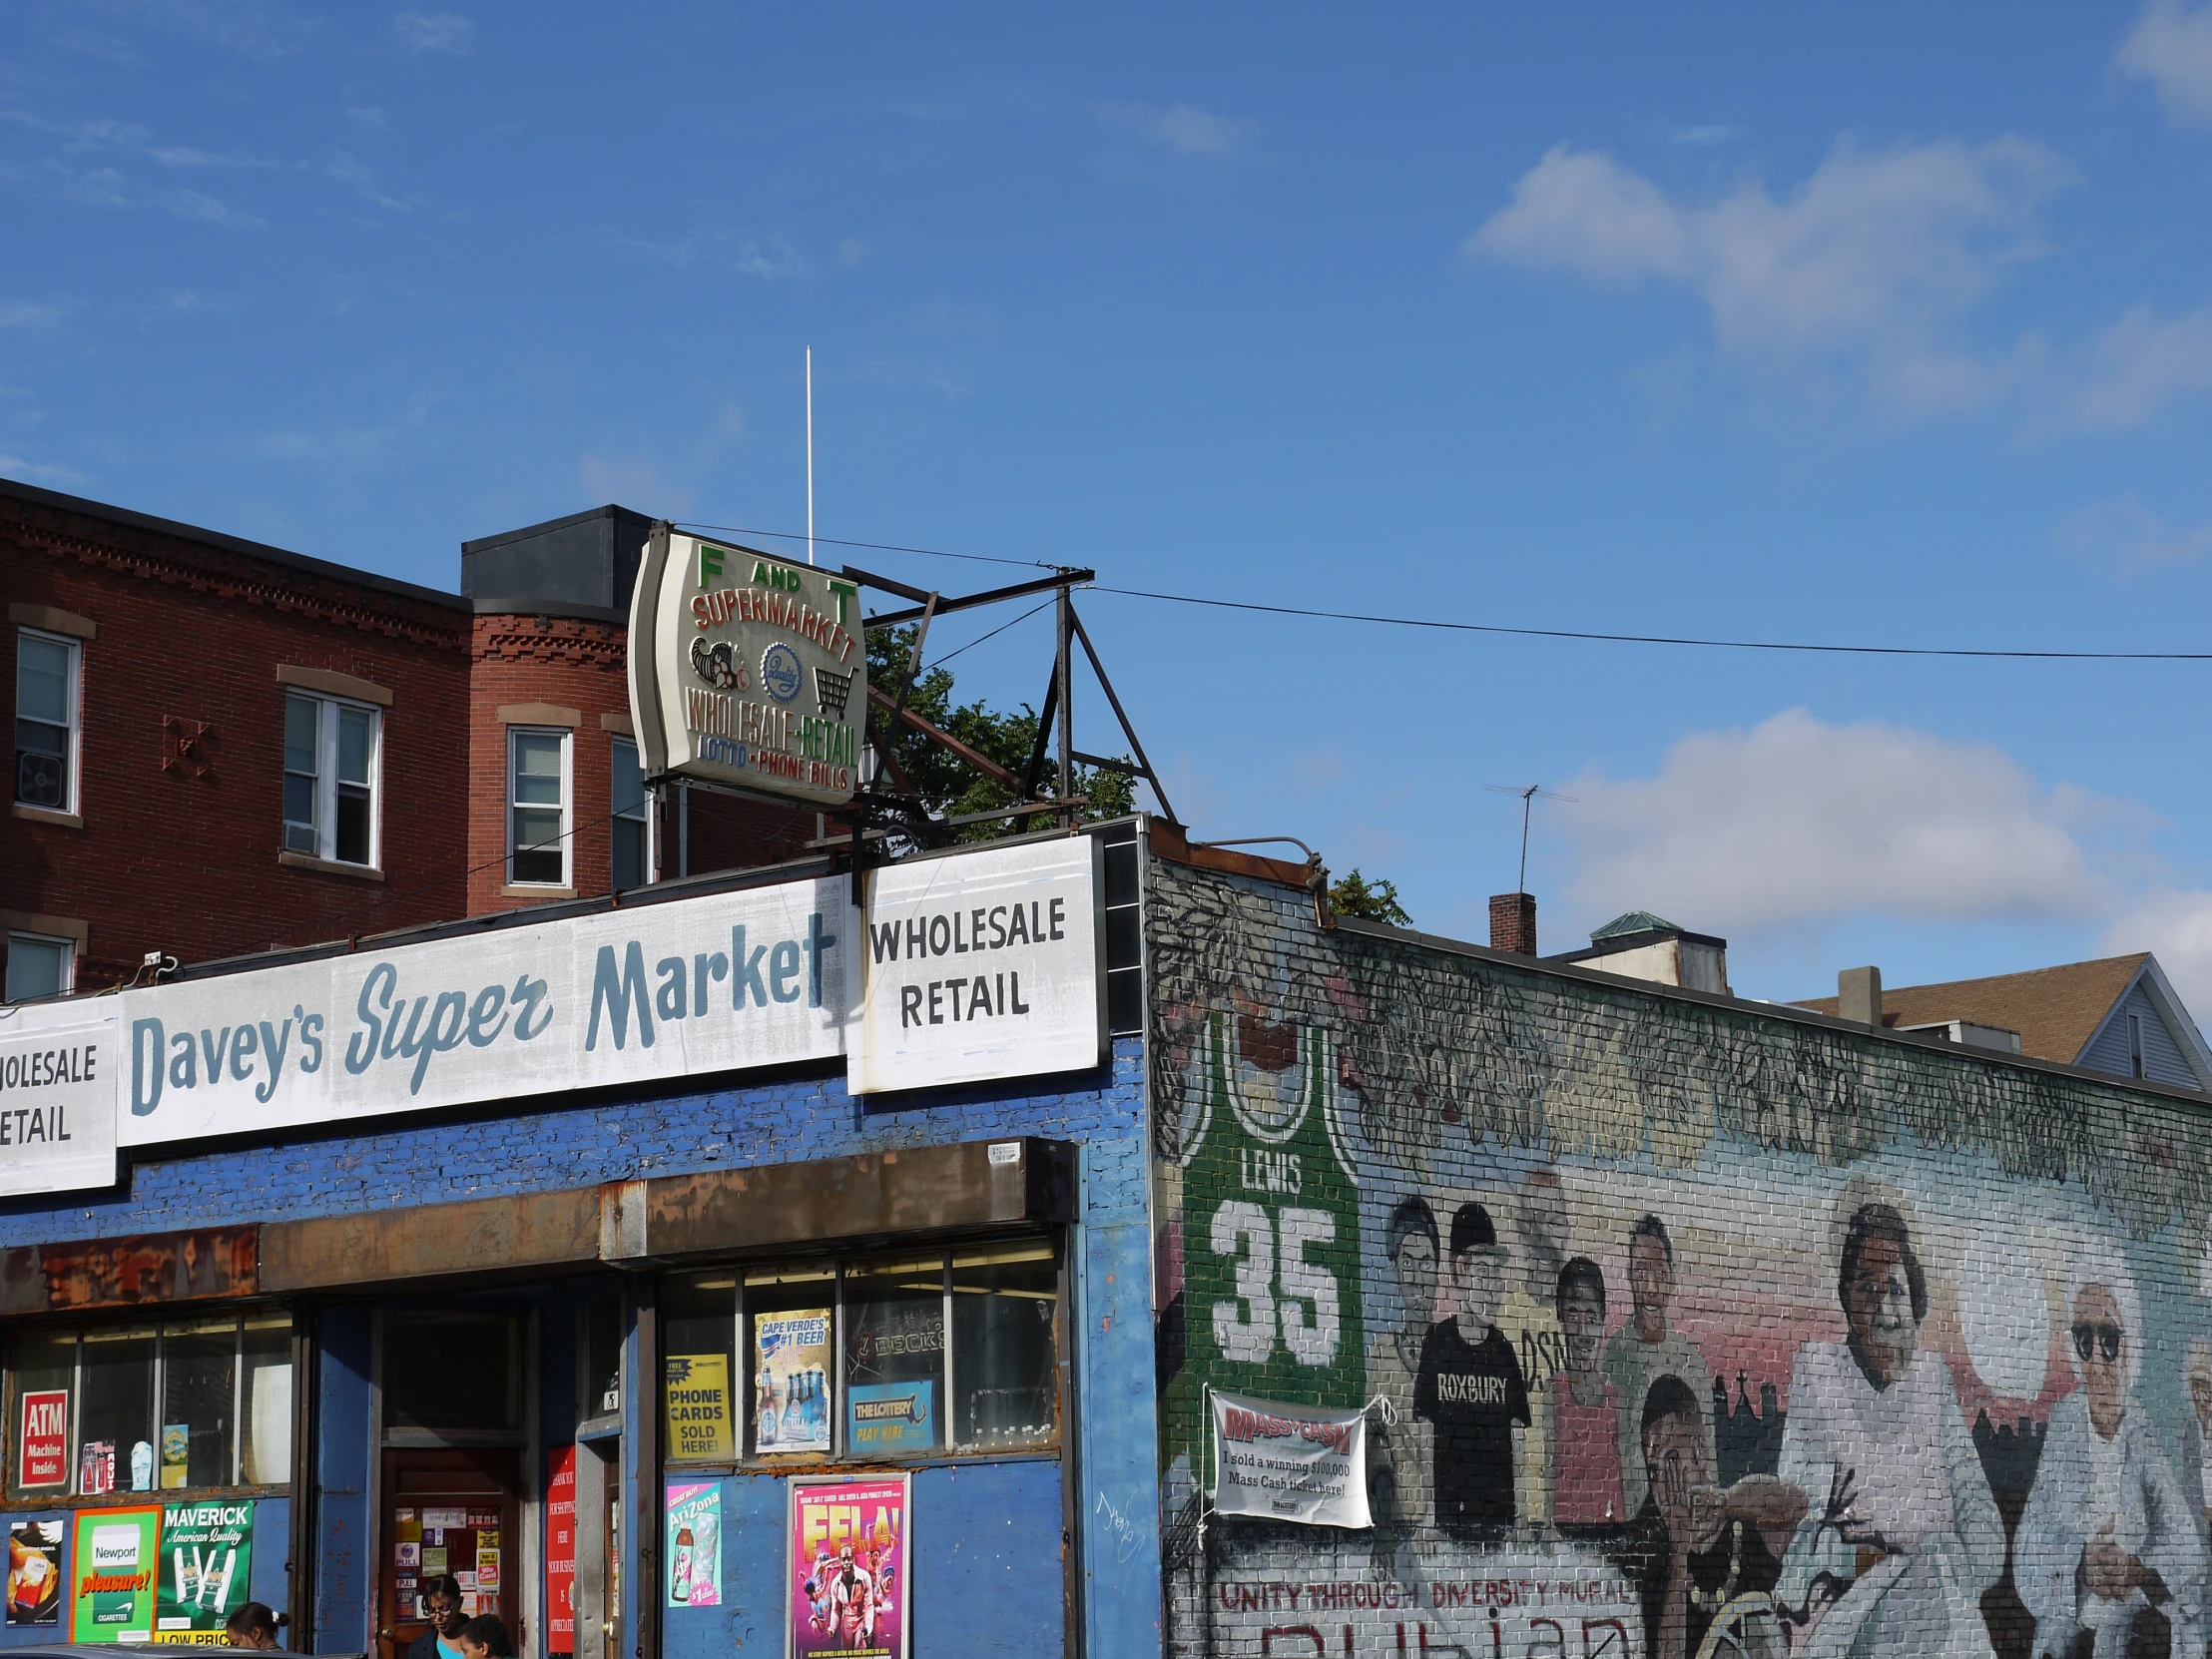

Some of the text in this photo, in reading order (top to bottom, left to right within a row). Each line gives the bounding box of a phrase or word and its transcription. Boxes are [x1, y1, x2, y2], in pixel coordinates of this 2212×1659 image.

[699, 544, 856, 625] F AND T
[691, 587, 856, 666] SUPERMARKET
[769, 655, 797, 693] Quality
[698, 735, 747, 767] LOTTO
[757, 750, 806, 781] PHONE
[810, 761, 847, 791] BILLS
[870, 897, 1065, 964] WHOLESALE
[900, 971, 1030, 1028] RETAIL
[131, 912, 835, 1117] Davey's Super Market
[0, 1045, 98, 1092] OLESALE
[0, 1105, 72, 1146] ETAIL
[1241, 1148, 1302, 1195] LEWIS
[1210, 1199, 1342, 1367] 35
[762, 1318, 825, 1335] CAPE VERDE'S
[780, 1331, 825, 1347] #1 BEER
[669, 1389, 722, 1403] PHONE
[1437, 1374, 1508, 1404] ROXBURY
[26, 1402, 63, 1436] ATM
[670, 1406, 724, 1421] CARDS
[1224, 1406, 1292, 1443] MASS
[681, 1425, 716, 1438] SOLD
[856, 1425, 904, 1441] PLAY HERE
[28, 1443, 61, 1457] Machine
[681, 1439, 719, 1453] HERE!
[32, 1461, 57, 1475] Inside
[1223, 1450, 1351, 1477] I sold a winning $100,000
[1228, 1471, 1346, 1495] Mass Cash ticket here!
[669, 1485, 699, 1507] GREAT BUY!
[165, 1506, 249, 1527] MAVERICK
[669, 1491, 720, 1532] AriZona
[167, 1526, 243, 1546] American Quality
[557, 1530, 569, 1543] HERE
[803, 1504, 899, 1563] FELA!
[96, 1546, 136, 1560] Newport
[548, 1561, 559, 1574] YOUR
[79, 1569, 151, 1598] pleasure!
[560, 1589, 565, 1602] IS
[692, 1587, 702, 1603] $1
[1220, 1580, 1631, 1612] UNITY THROUGH DIVERSITY MURAL
[98, 1613, 128, 1622] CIGARETTES
[196, 1634, 231, 1645] PRIC
